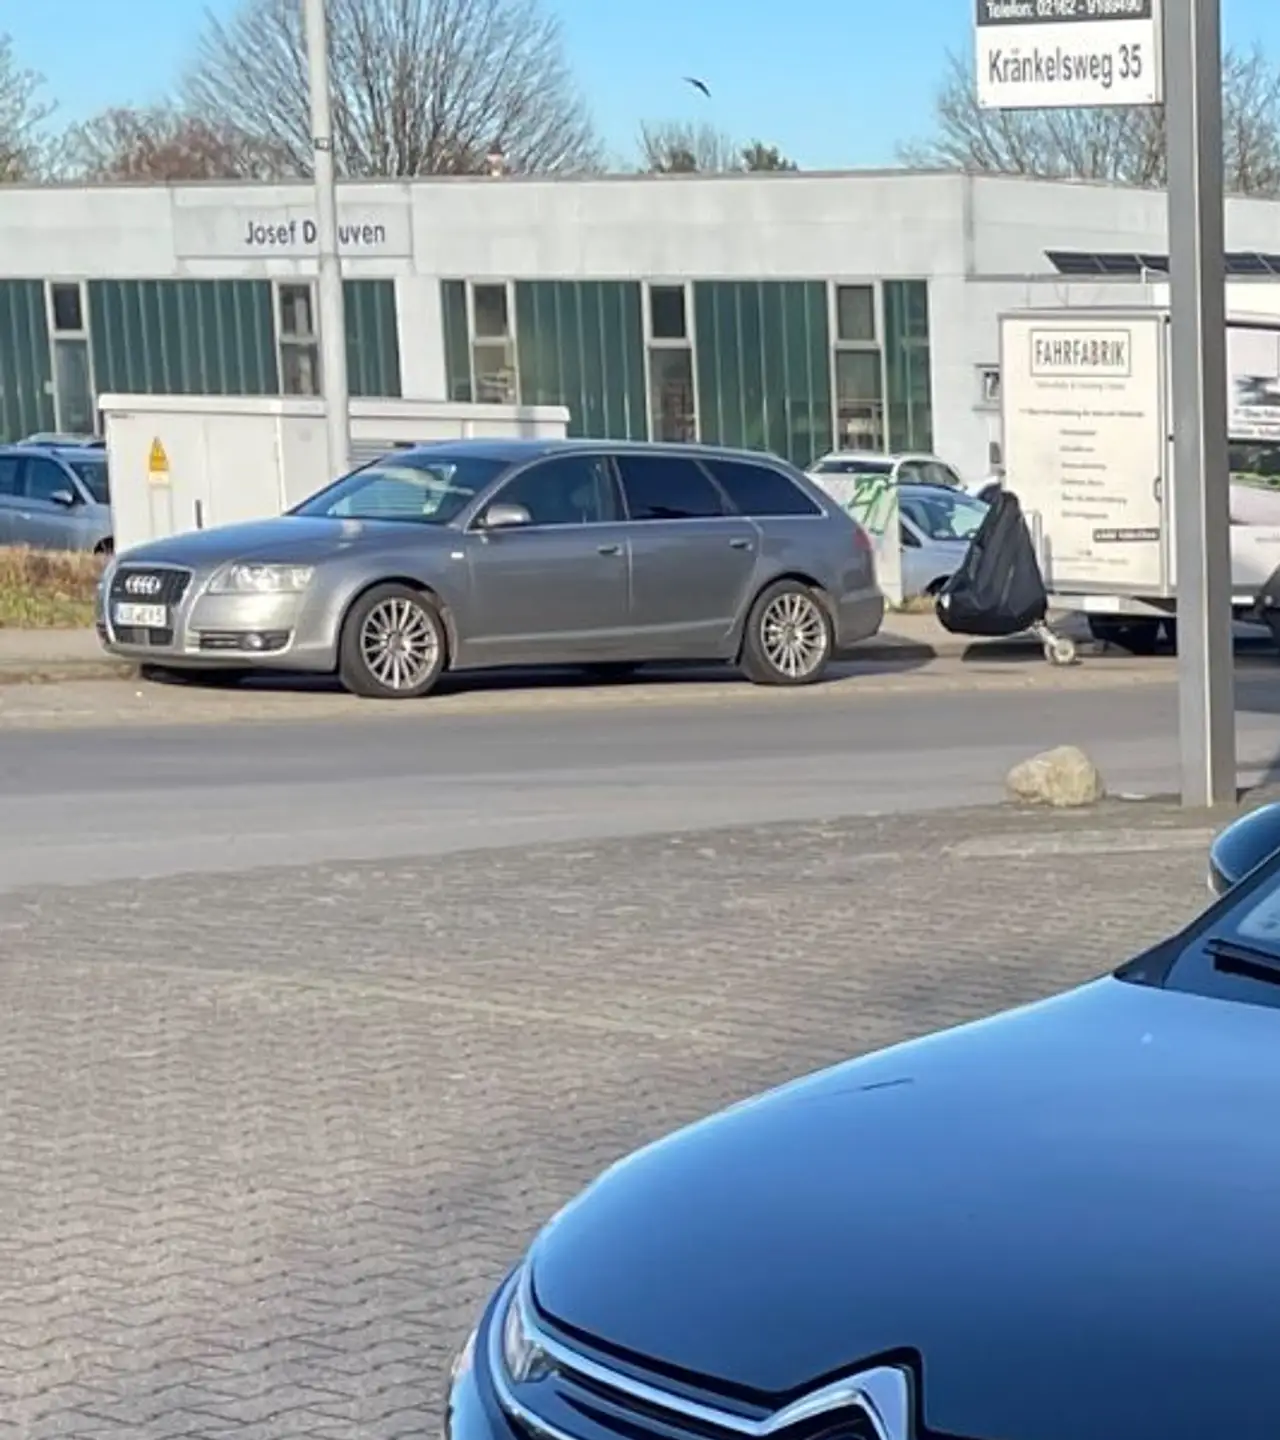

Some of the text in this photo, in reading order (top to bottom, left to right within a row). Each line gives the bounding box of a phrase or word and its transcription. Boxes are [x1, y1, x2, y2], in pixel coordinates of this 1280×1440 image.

[986, 1, 1033, 18] Telefon:
[988, 43, 1142, 88] Kränkelsweg 35
[244, 219, 386, 245] Josef Duven
[1035, 339, 1125, 366] FAHRFABRIK
